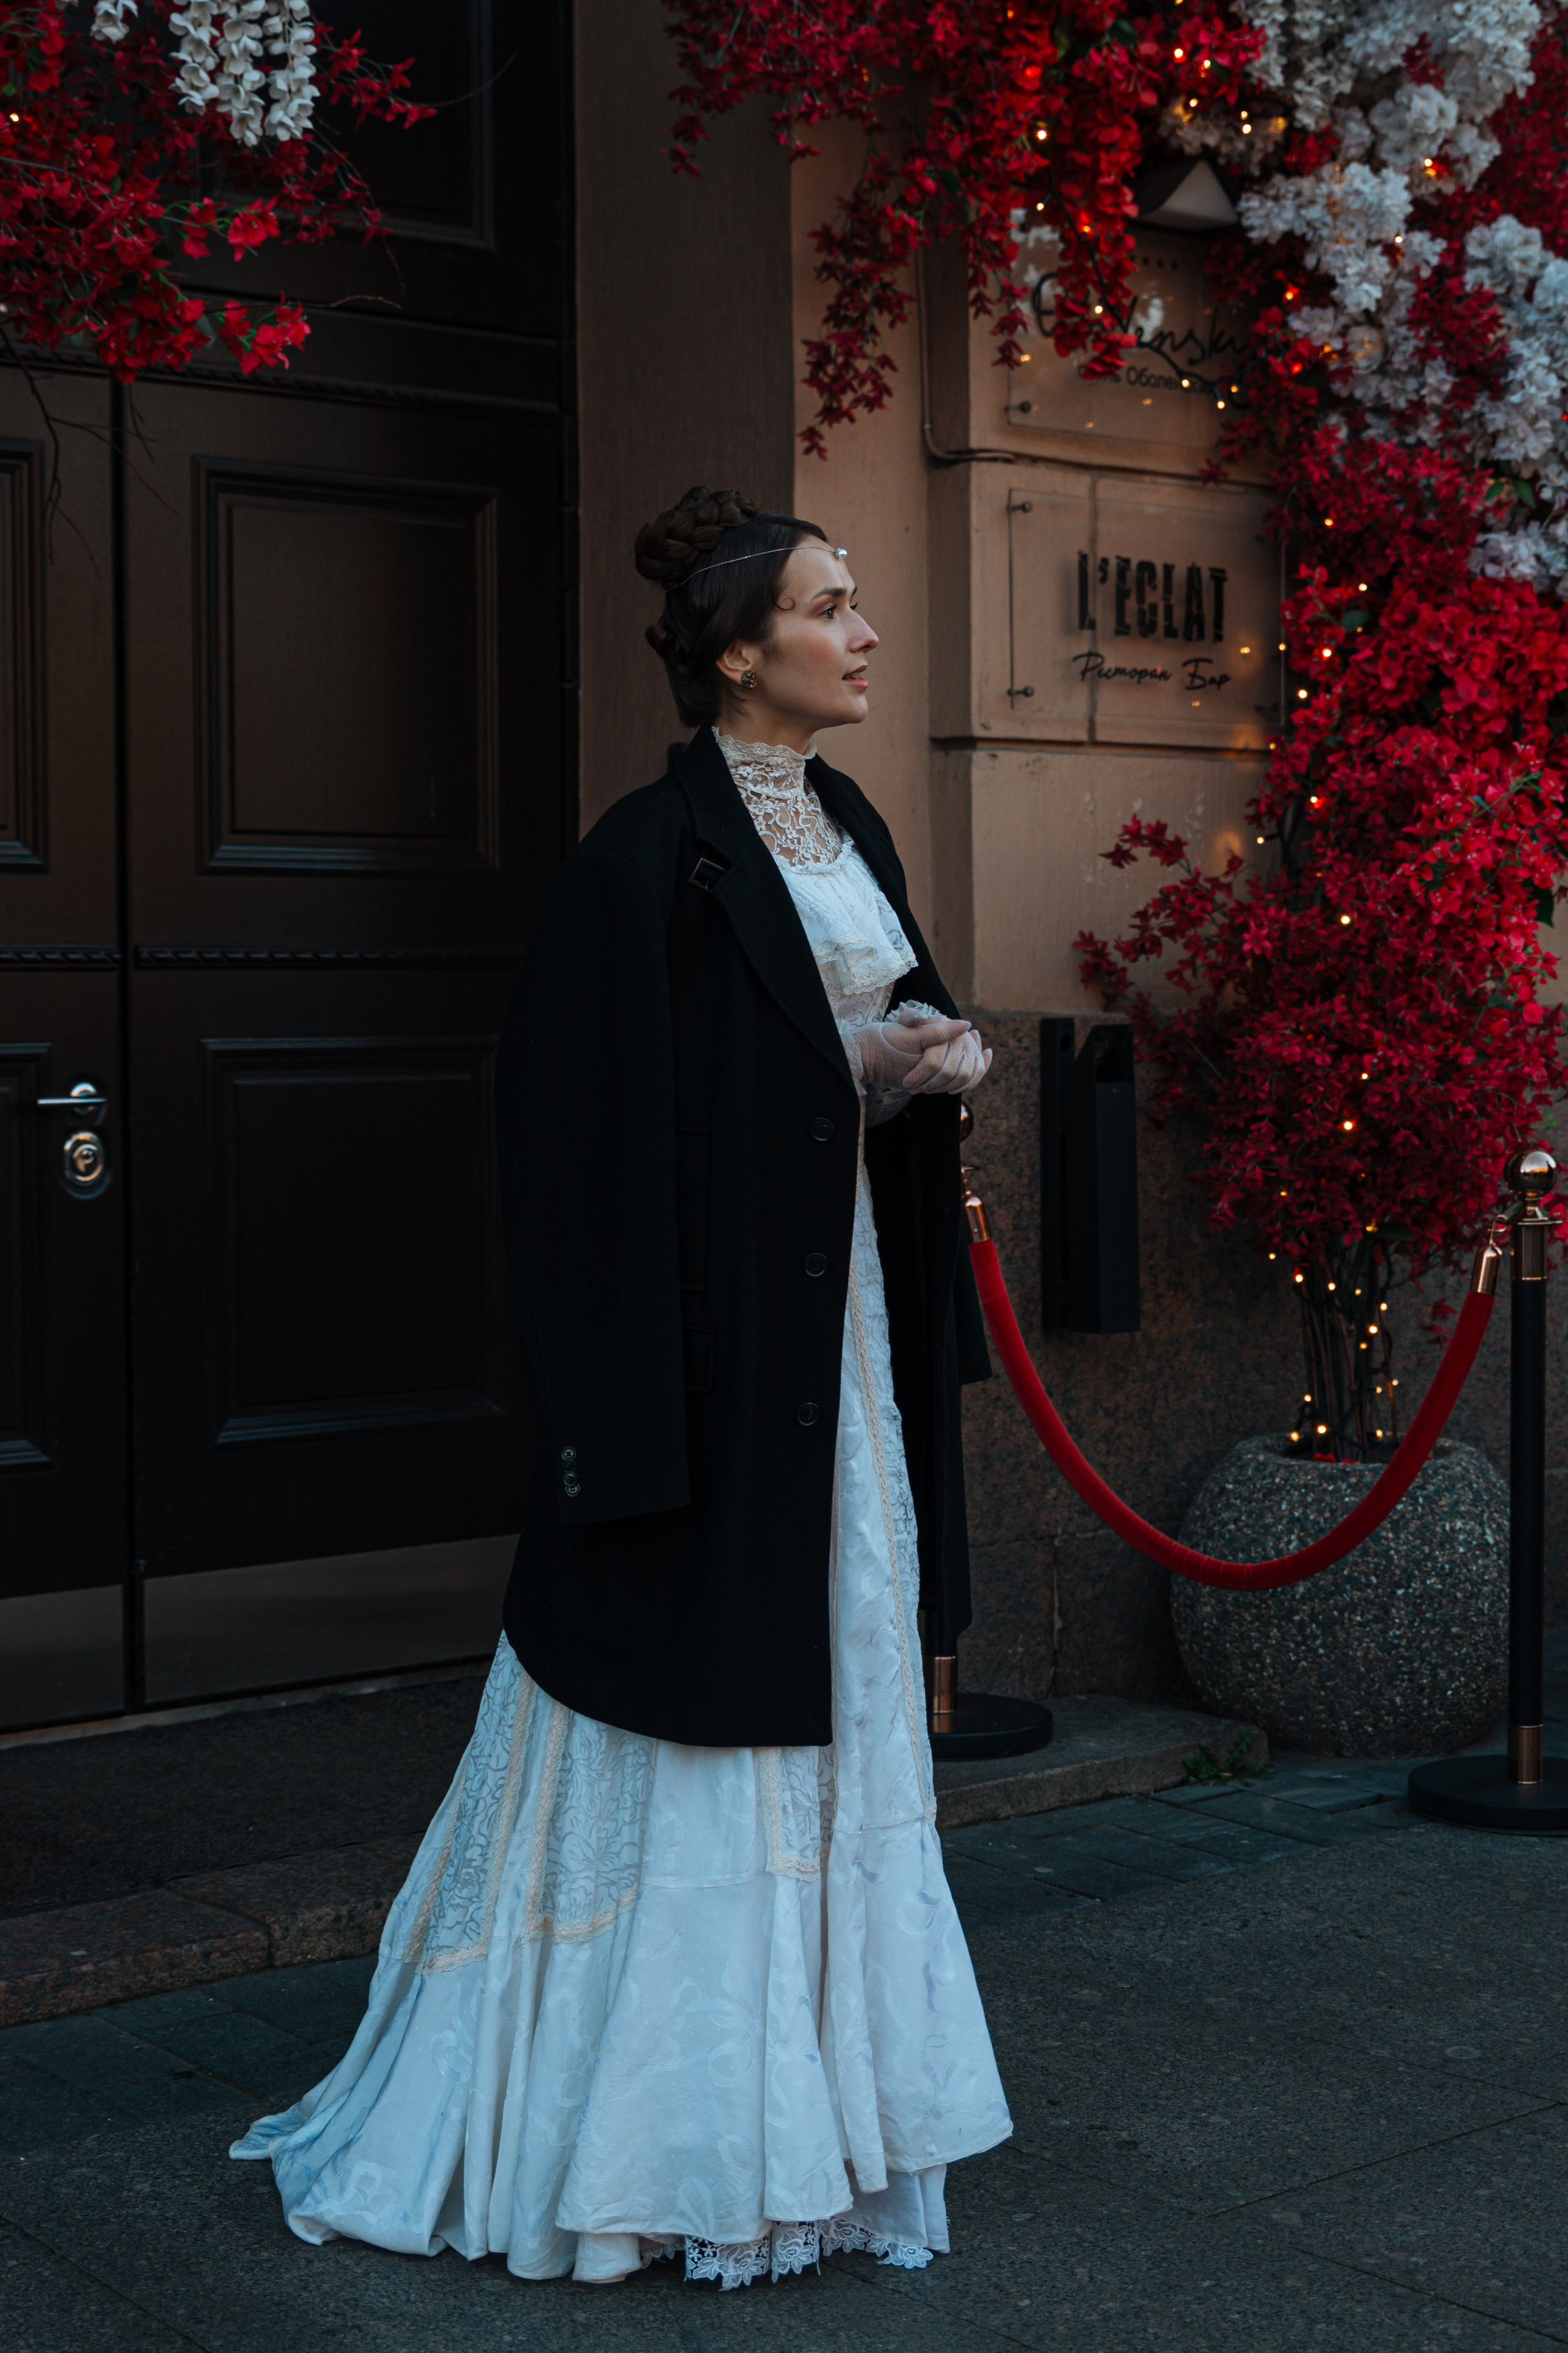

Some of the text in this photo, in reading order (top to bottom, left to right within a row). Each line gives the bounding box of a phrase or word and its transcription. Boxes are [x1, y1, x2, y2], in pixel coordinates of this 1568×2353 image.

[1077, 551, 1227, 643] L'ECLAT
[1072, 650, 1231, 690] Ресторан Бар
